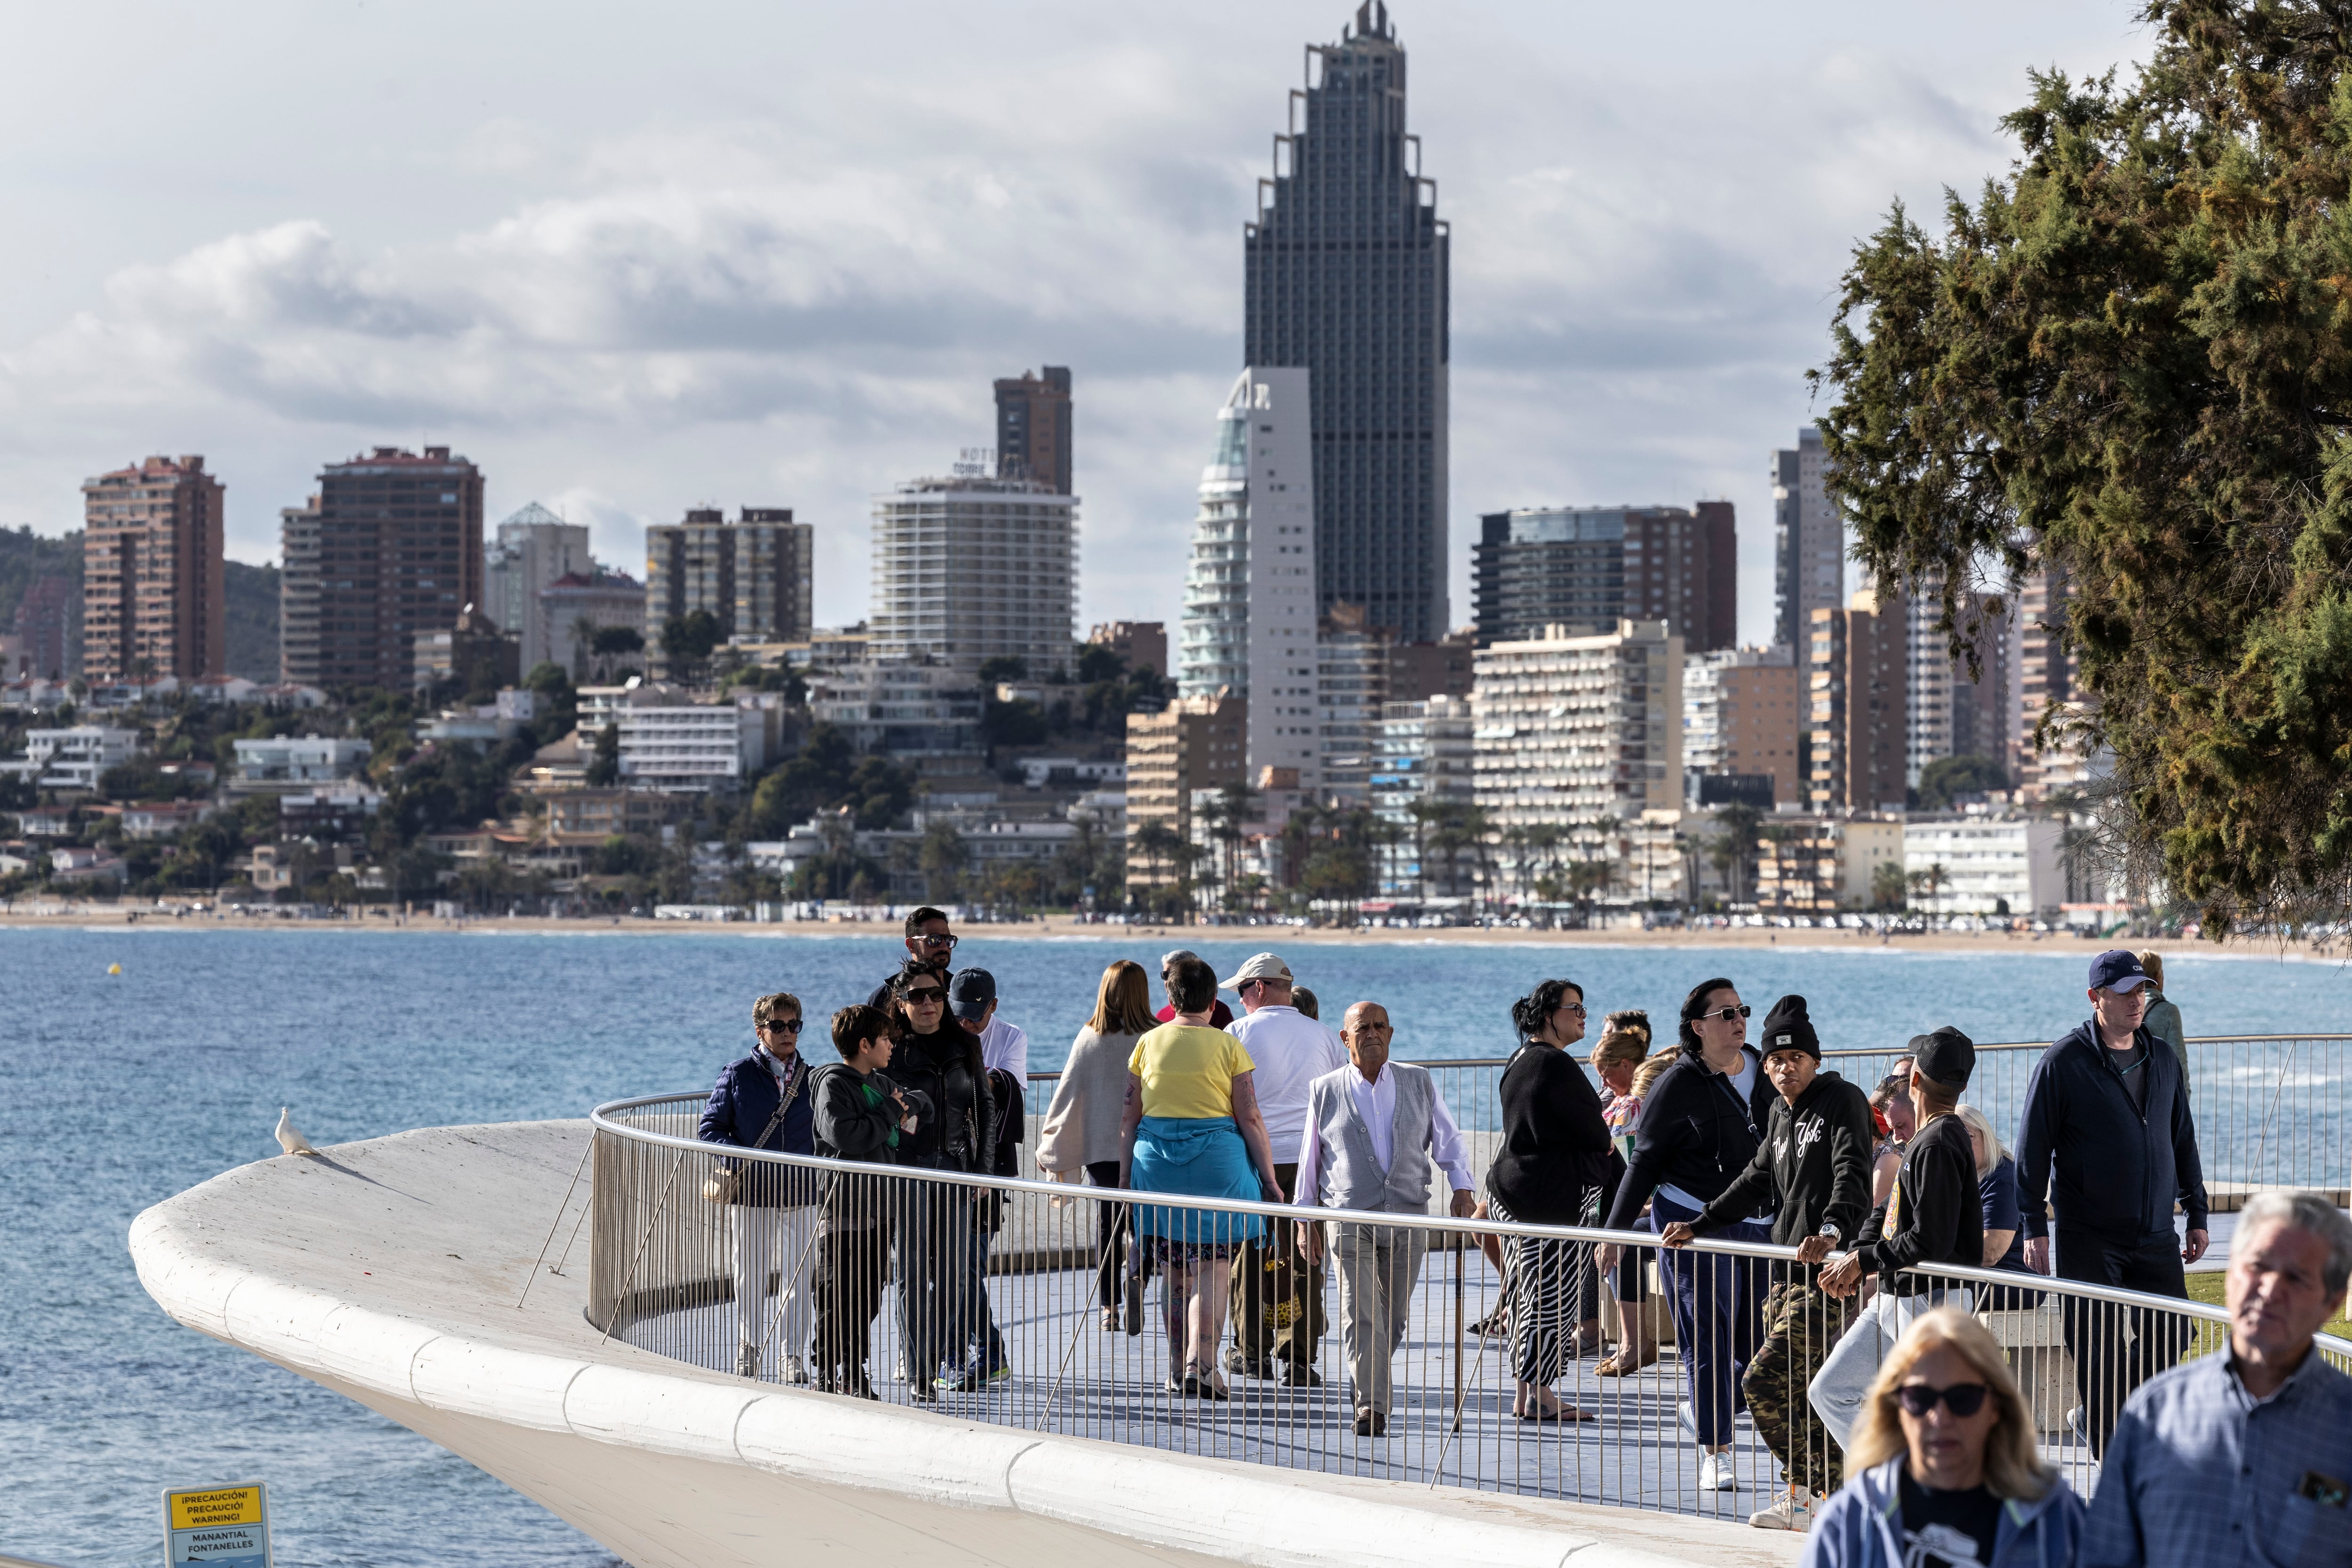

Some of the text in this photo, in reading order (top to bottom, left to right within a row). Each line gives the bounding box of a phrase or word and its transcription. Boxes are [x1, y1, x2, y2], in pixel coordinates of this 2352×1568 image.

[182, 1491, 247, 1504] ¡PRECAUCIÓN!
[187, 1501, 243, 1514] PRECAUCIÓ!
[191, 1513, 240, 1523] WARNING!
[192, 1530, 248, 1542] MANANTIAL
[189, 1540, 253, 1552] FONTANELLES
